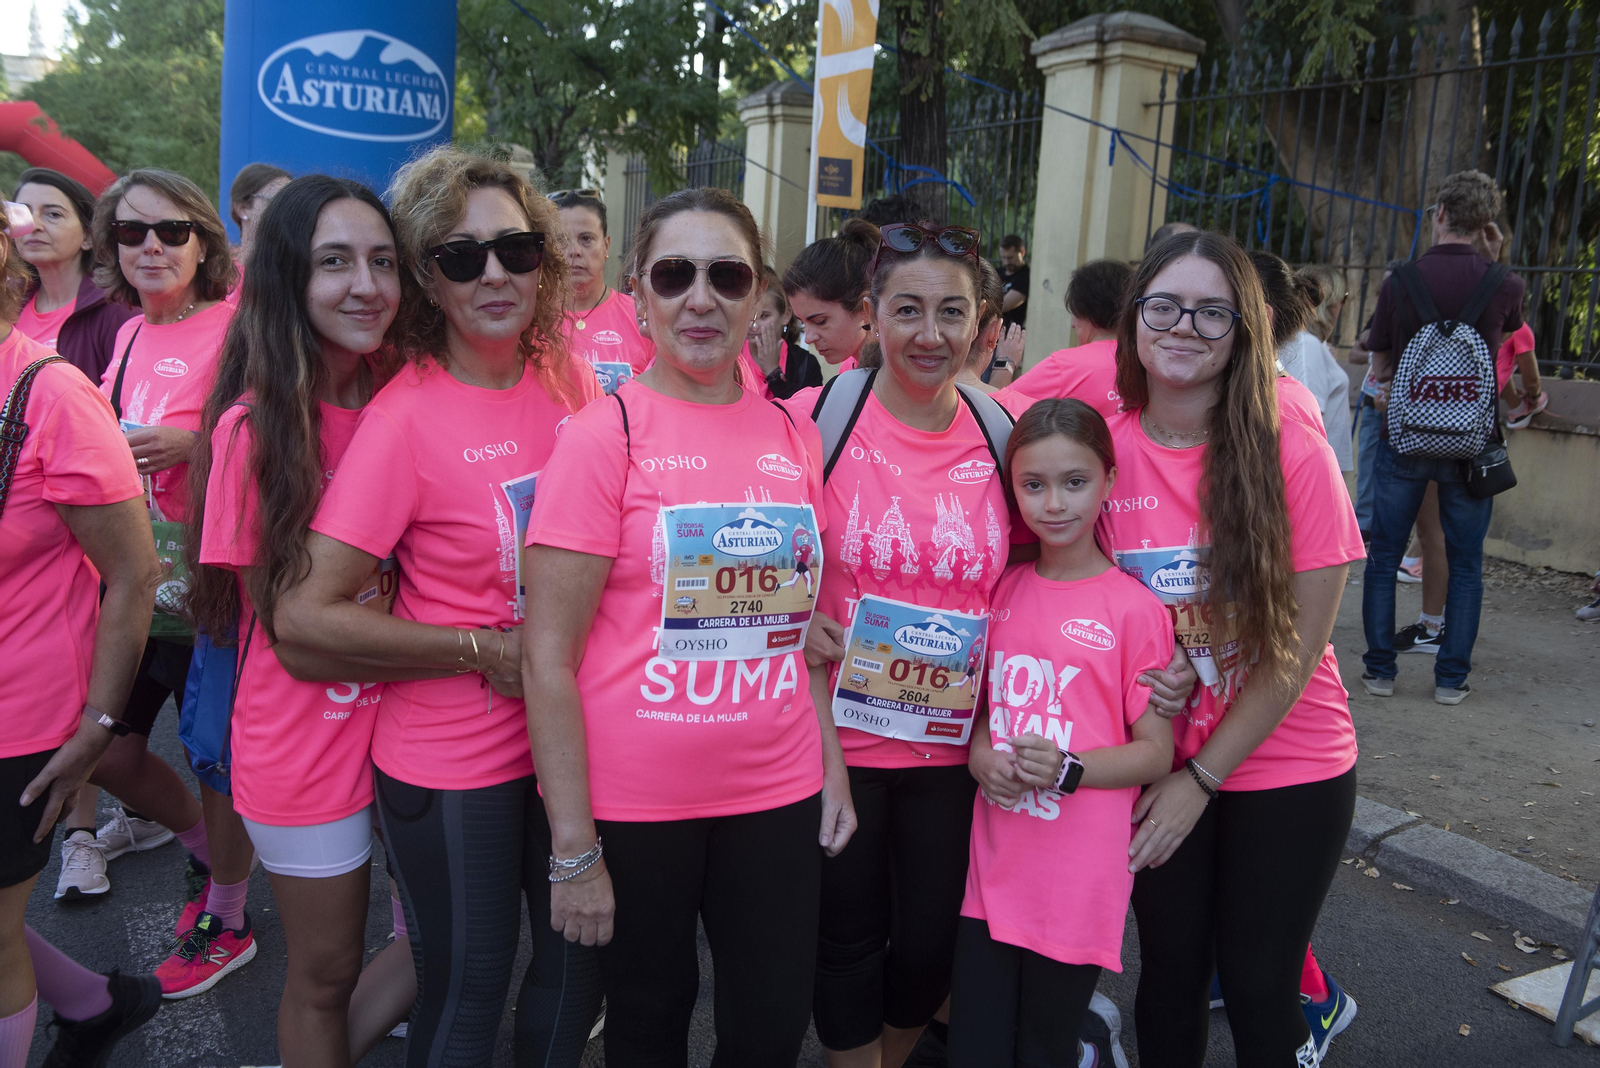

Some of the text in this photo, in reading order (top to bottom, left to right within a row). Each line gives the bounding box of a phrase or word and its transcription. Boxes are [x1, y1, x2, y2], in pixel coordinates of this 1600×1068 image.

[305, 62, 379, 81] CENTRAL
[272, 62, 442, 121] ASTURIANA
[1409, 376, 1481, 402] VANS
[463, 440, 518, 463] OYSHO
[641, 455, 707, 472] OYSHO
[762, 460, 800, 476] ASTURIANA
[851, 446, 902, 476] OYSO
[953, 470, 994, 480] ASTURIAN
[1102, 496, 1158, 513] OYSHO
[677, 529, 704, 538] SUMA
[717, 533, 779, 548] ASTURIANA
[715, 566, 778, 594] 016
[1155, 574, 1211, 588] ASTURIAN
[730, 600, 763, 614] 2740
[698, 615, 790, 628] CARRERA DE LA MUJER
[864, 616, 890, 629] SUMA
[872, 613, 891, 622] DORSAL
[777, 634, 797, 643] Santander
[898, 629, 958, 652] ASTURIANA
[911, 630, 957, 642] CENTRAL LECHERA
[1064, 623, 1113, 648] ASTURIANA
[1178, 632, 1211, 646] 2742
[675, 638, 728, 651] OYSHO
[1187, 648, 1198, 657] DE
[1200, 648, 1211, 656] LA
[640, 654, 798, 706] SUMA
[888, 658, 951, 689] 016
[989, 651, 1082, 715] HOY
[356, 700, 368, 708] DE
[898, 689, 930, 704] 2604
[866, 697, 952, 718] CARRERA DE LA MUJER
[636, 709, 748, 723] CARRERA DE LA MUJER
[844, 708, 890, 728] OYSHO
[936, 726, 958, 734] Santander
